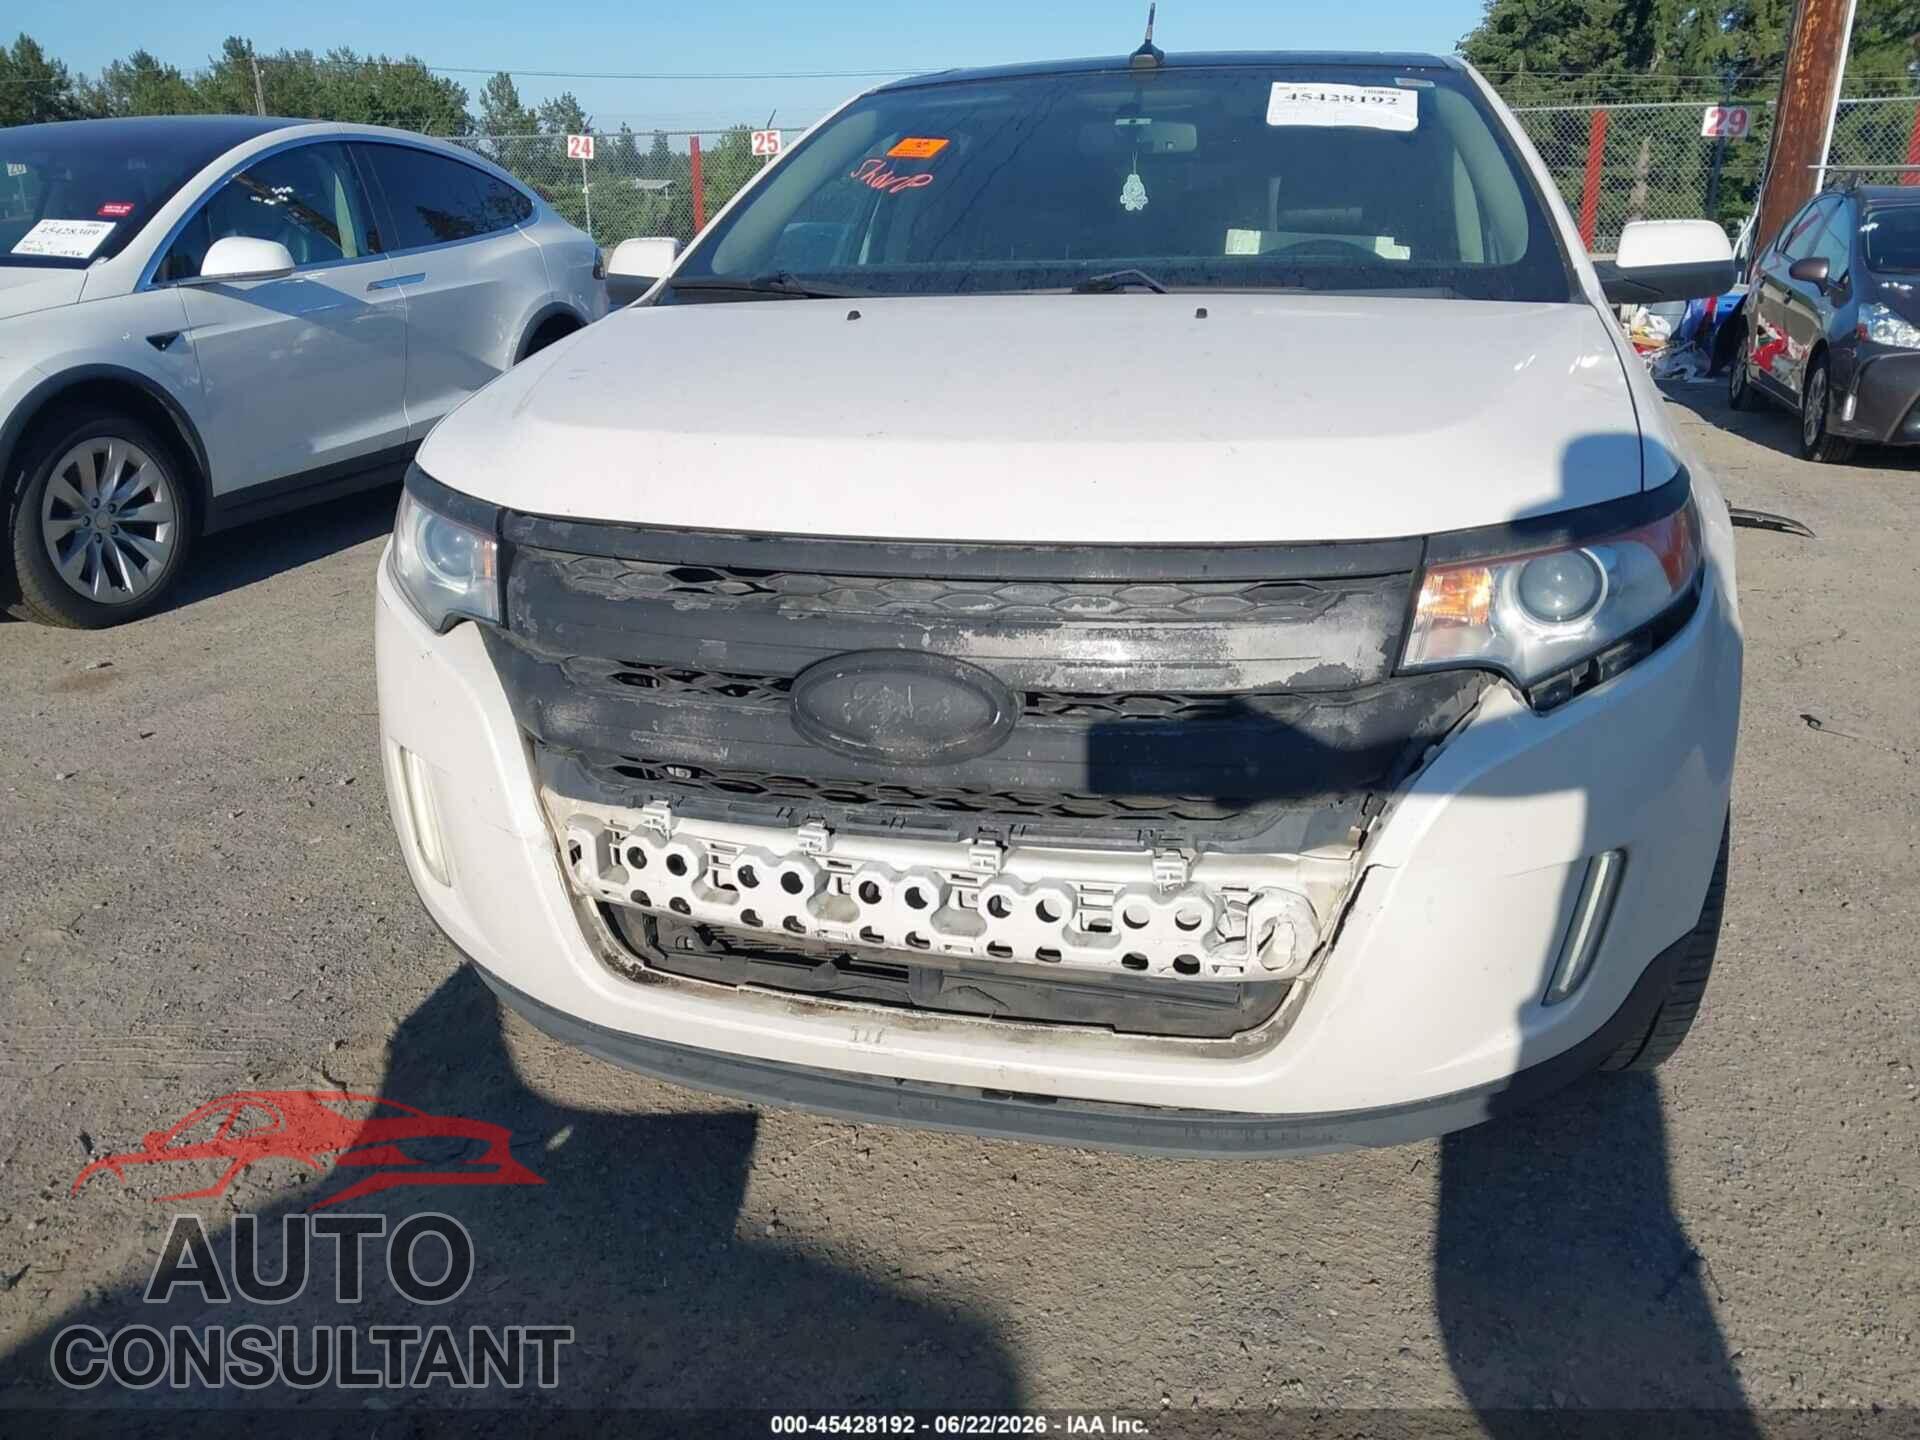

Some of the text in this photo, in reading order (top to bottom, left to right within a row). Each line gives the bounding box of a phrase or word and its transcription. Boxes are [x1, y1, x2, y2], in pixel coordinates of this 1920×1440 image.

[1284, 92, 1399, 106] 45428192
[1707, 108, 1747, 135] 29
[570, 137, 592, 157] 24
[755, 132, 779, 154] 25
